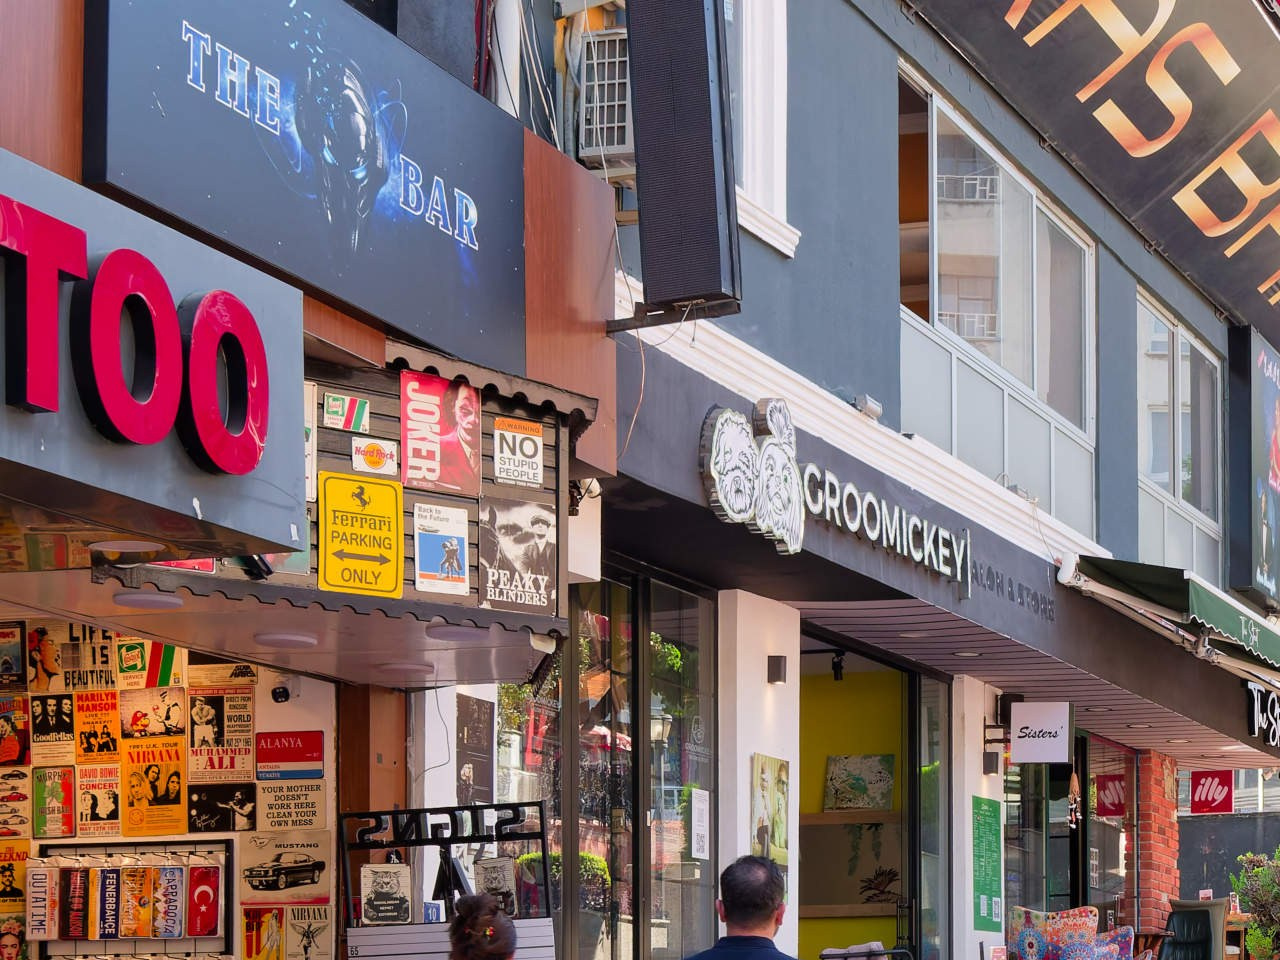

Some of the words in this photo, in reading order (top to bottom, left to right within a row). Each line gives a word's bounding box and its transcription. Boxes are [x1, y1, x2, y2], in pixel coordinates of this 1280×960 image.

[182, 20, 281, 136] THE
[399, 153, 479, 250] BAR
[0, 194, 269, 475] TOO
[407, 381, 441, 482] JOKER
[506, 423, 540, 434] WARNING
[354, 446, 375, 458] Hard
[500, 433, 538, 459] NO
[499, 457, 539, 471] STUPID
[499, 467, 539, 481] PEOPLE
[331, 509, 392, 533] Ferrari
[803, 462, 965, 583] GROOMICKEY
[331, 531, 392, 550] PARKING
[341, 568, 382, 585] ONLY
[486, 568, 549, 593] PEAKY
[486, 586, 548, 606] BLINDERS
[92, 645, 110, 665] IS
[64, 669, 115, 688] BEAUTIFUL
[76, 692, 117, 703] MARILYN
[77, 702, 117, 713] MANSON
[1247, 681, 1269, 738] The
[227, 714, 252, 723] WORLD
[259, 737, 303, 750] ALANYA
[128, 748, 180, 764] NIRVANA
[190, 748, 251, 757] MUHAMMED
[204, 756, 236, 770] ALI
[79, 768, 98, 779] DAVID
[99, 767, 119, 779] BOWIE
[79, 782, 119, 791] CONCERT
[261, 785, 284, 793] YOUR
[286, 784, 321, 793] MOTHER
[1194, 777, 1229, 807] illy
[274, 793, 309, 801] DOESN'T
[267, 802, 291, 810] WORK
[266, 811, 293, 819] CLEAN
[295, 810, 317, 818] YOUR
[291, 818, 314, 827] MESS
[31, 873, 47, 935] OUTATIME
[103, 872, 117, 935] FENERBAHÇE
[163, 870, 177, 935] CAPPADOCIA
[290, 907, 328, 921] NIRVANA
[428, 908, 437, 921] 10
[350, 947, 359, 956] 65
